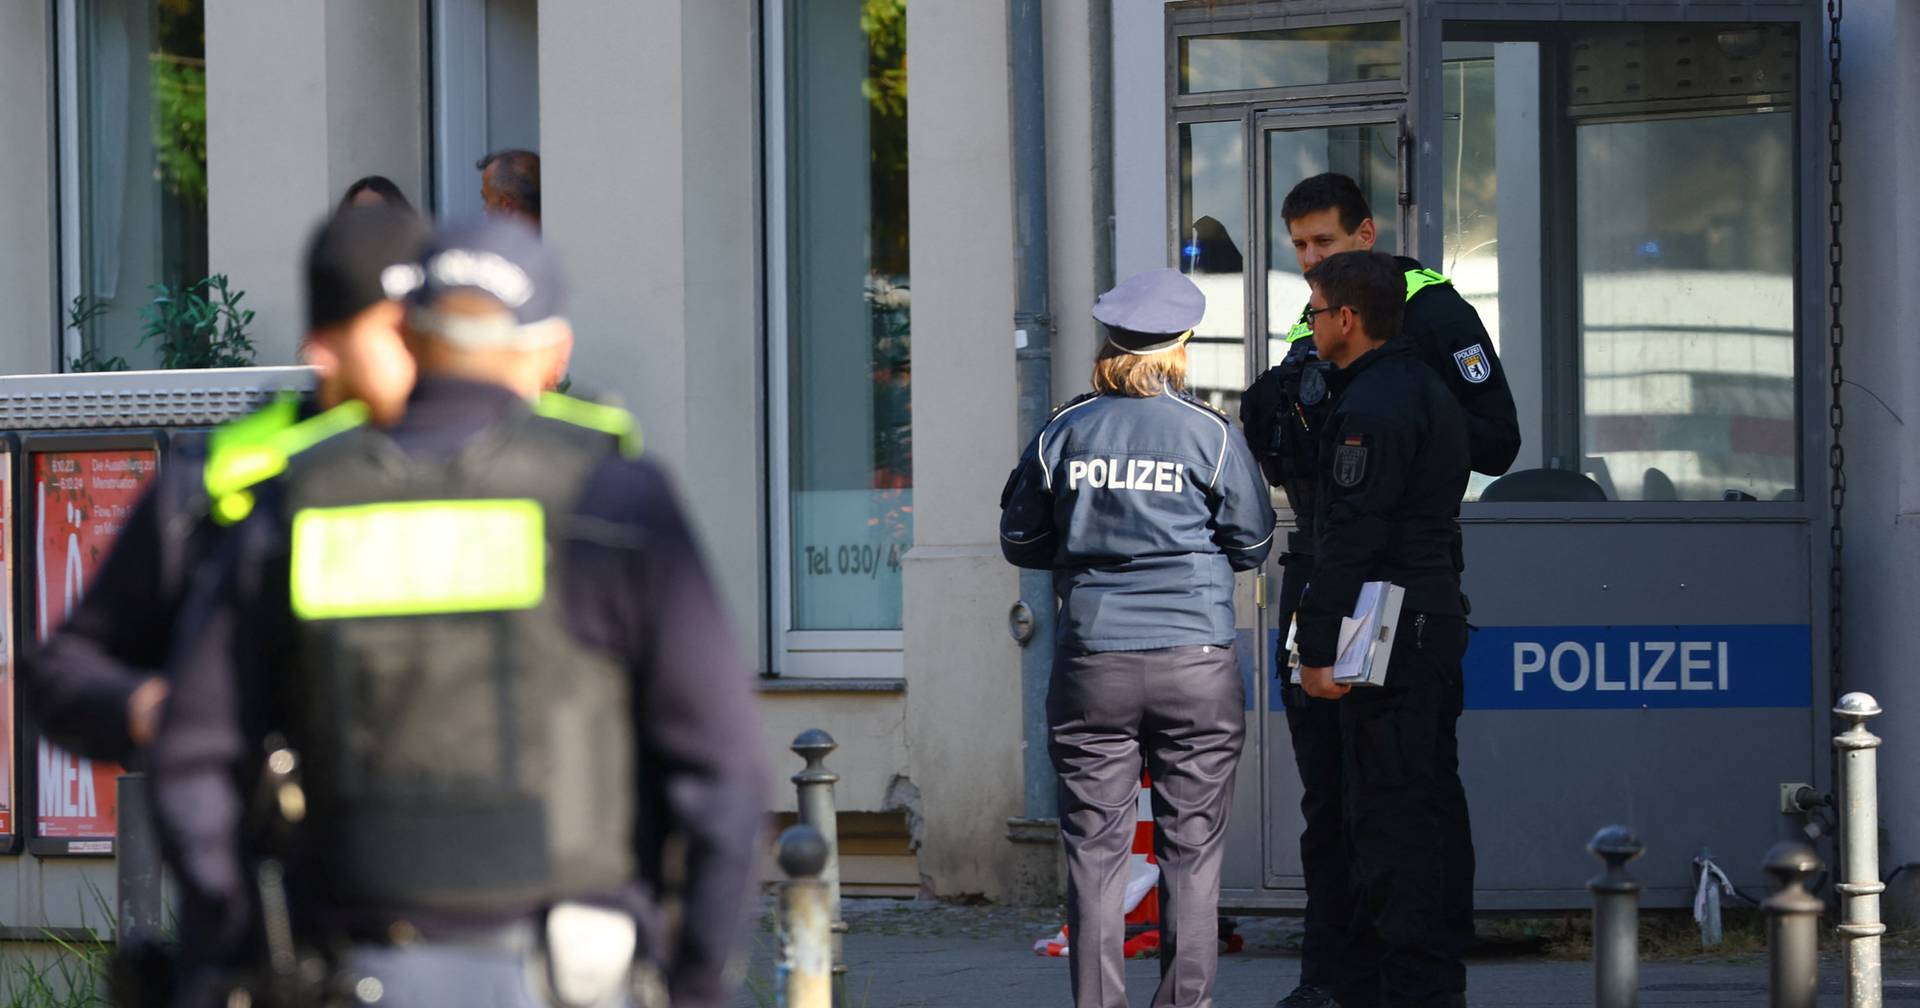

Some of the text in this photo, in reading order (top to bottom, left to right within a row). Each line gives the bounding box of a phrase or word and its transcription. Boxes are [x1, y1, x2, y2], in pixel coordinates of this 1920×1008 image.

[1456, 346, 1480, 361] POLIZEI
[1069, 458, 1184, 493] POLIZEI
[805, 545, 832, 575] Tel.
[1513, 641, 1728, 691] POLIZEI
